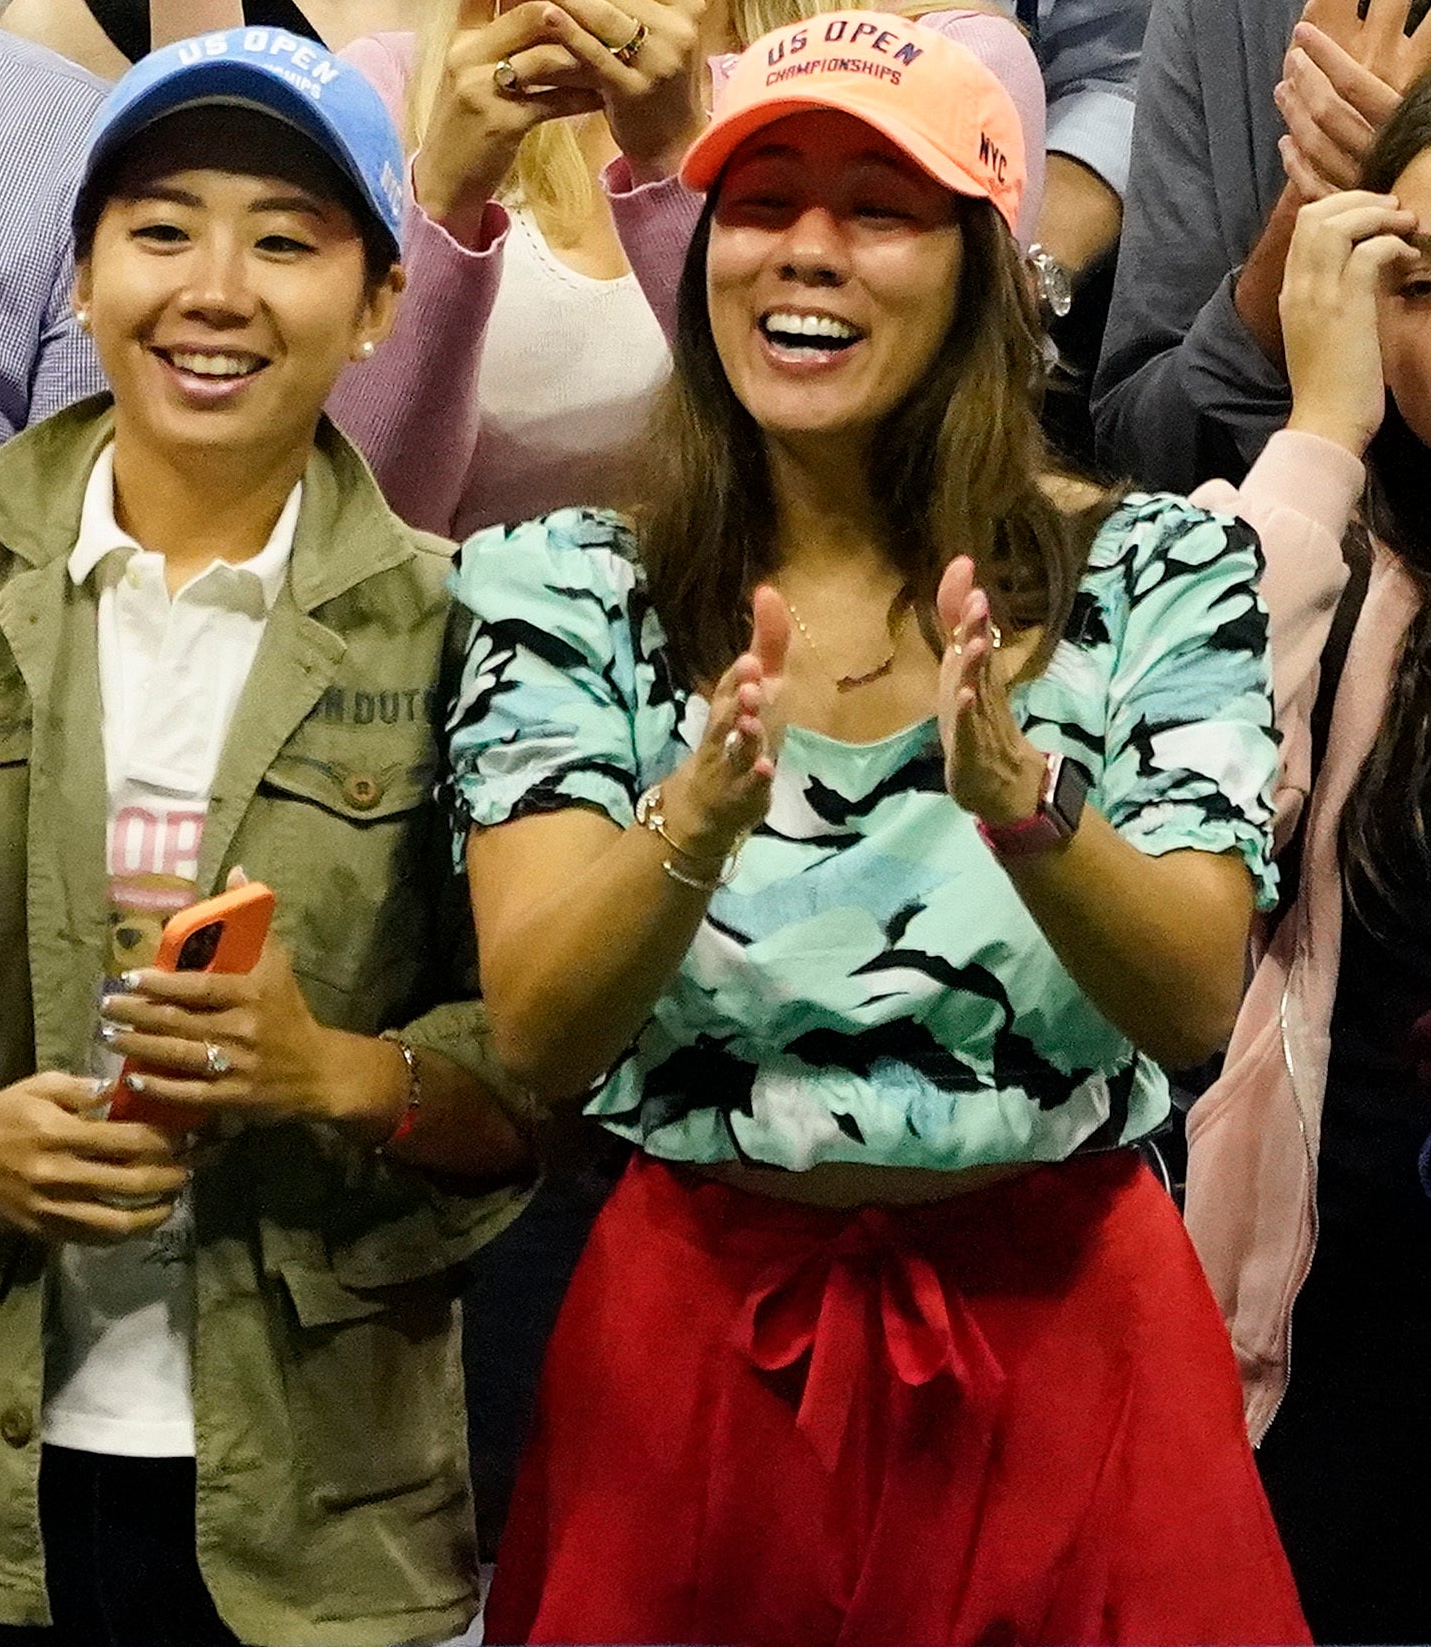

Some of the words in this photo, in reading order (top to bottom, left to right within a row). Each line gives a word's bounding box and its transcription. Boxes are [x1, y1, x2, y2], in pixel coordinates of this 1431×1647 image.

[177, 32, 228, 65] US
[243, 29, 339, 86] OPEN
[767, 28, 809, 67] US
[824, 20, 924, 67] OPEN
[766, 57, 902, 87] CHAMPIONSHIPS
[979, 132, 1008, 183] NYC
